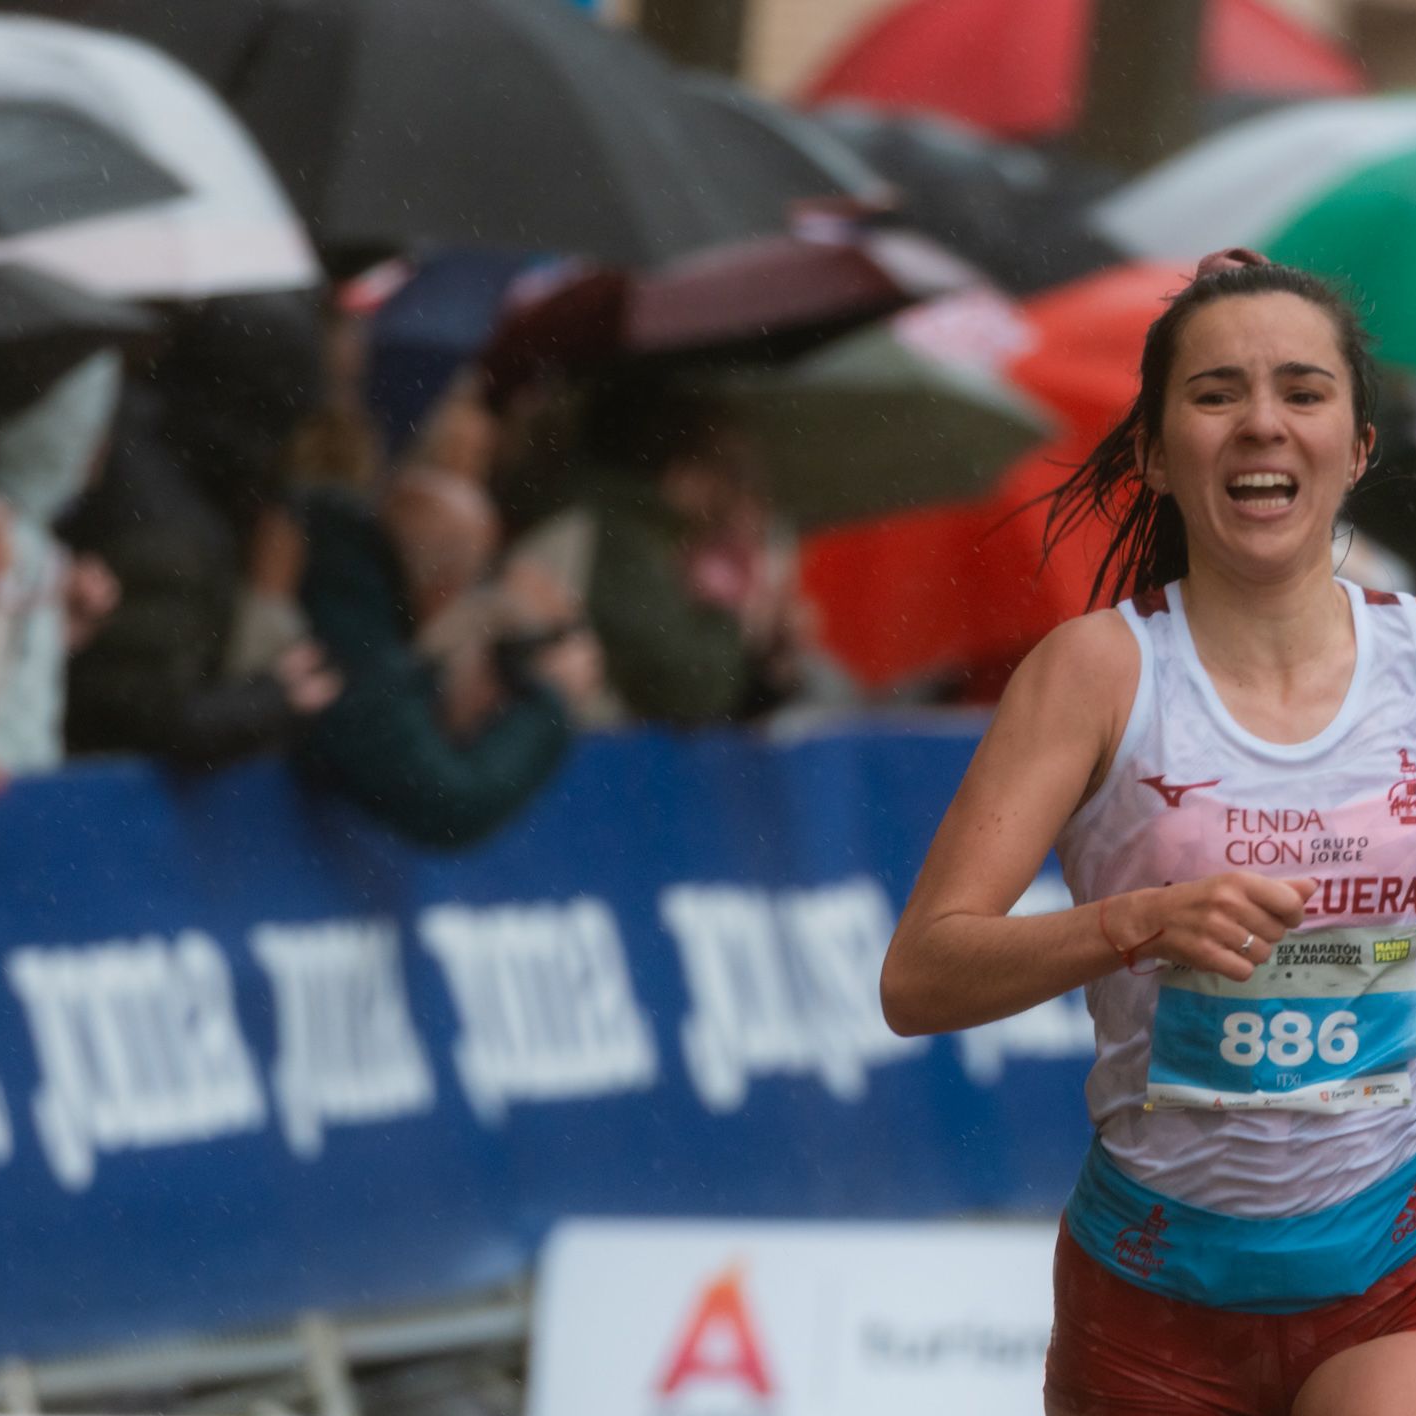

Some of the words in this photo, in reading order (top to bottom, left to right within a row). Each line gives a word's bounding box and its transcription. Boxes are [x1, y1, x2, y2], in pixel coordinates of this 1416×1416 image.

[1225, 834, 1302, 866] CIÓN
[1310, 836, 1369, 850] GRUPO
[1310, 850, 1364, 864] JORGE
[1276, 944, 1296, 955] XIX
[1300, 943, 1362, 955] MARATÓN
[1276, 955, 1291, 965] DE
[1293, 954, 1362, 965] ZARAGOZA
[1219, 1010, 1359, 1067] 886
